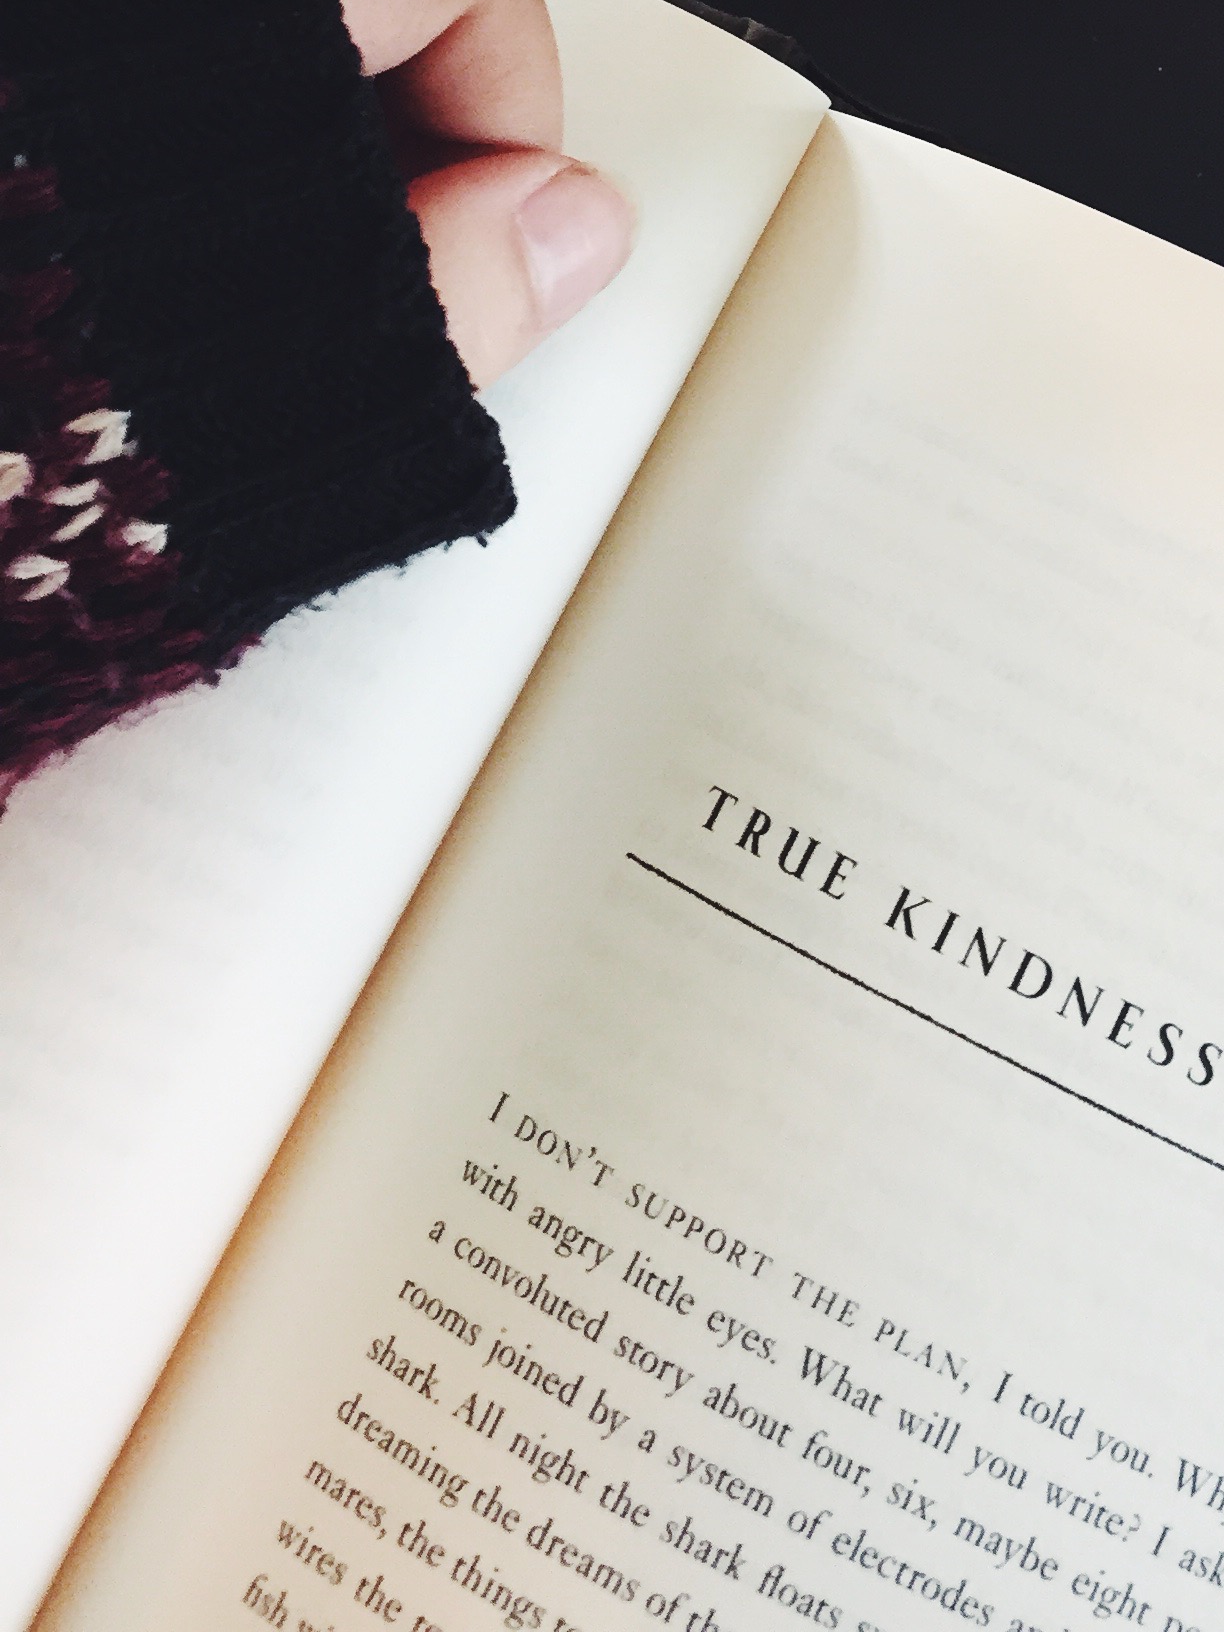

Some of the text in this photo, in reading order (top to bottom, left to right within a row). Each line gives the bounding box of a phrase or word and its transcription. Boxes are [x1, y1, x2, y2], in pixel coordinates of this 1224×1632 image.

[701, 784, 1224, 1087] TRUE KINDNESS
[428, 1220, 1152, 1626] a convoluted story about four, six, maybe eight
[462, 1159, 519, 1212] with
[527, 1206, 615, 1274] angry
[621, 1250, 696, 1316] little
[706, 1309, 777, 1365] eyes.
[800, 1345, 883, 1418] What
[898, 1408, 962, 1455] will
[962, 1445, 1028, 1490] you
[1046, 1481, 1142, 1543] write?
[1150, 1525, 1172, 1558] I
[487, 1090, 511, 1124] I
[624, 1183, 775, 1279] SUPPORT
[791, 1271, 860, 1328] THE
[872, 1317, 971, 1395] PLAN,
[991, 1370, 1014, 1404] I
[1019, 1393, 1086, 1440] told
[1085, 1429, 1153, 1479] you.
[242, 1573, 288, 1630] fish
[276, 1519, 403, 1624] wires the
[304, 1460, 546, 1629] mares, the things
[336, 1394, 470, 1508] dreaming
[471, 1485, 521, 1534] the
[525, 1517, 641, 1602] dreams
[644, 1592, 691, 1625] of
[365, 1335, 440, 1405] shark.
[451, 1392, 507, 1440] All
[508, 1432, 590, 1494] night
[599, 1480, 651, 1528] the
[658, 1515, 746, 1581] shark
[757, 1564, 843, 1630] floats
[398, 1279, 995, 1627] rooms joined by a system of electrodes
